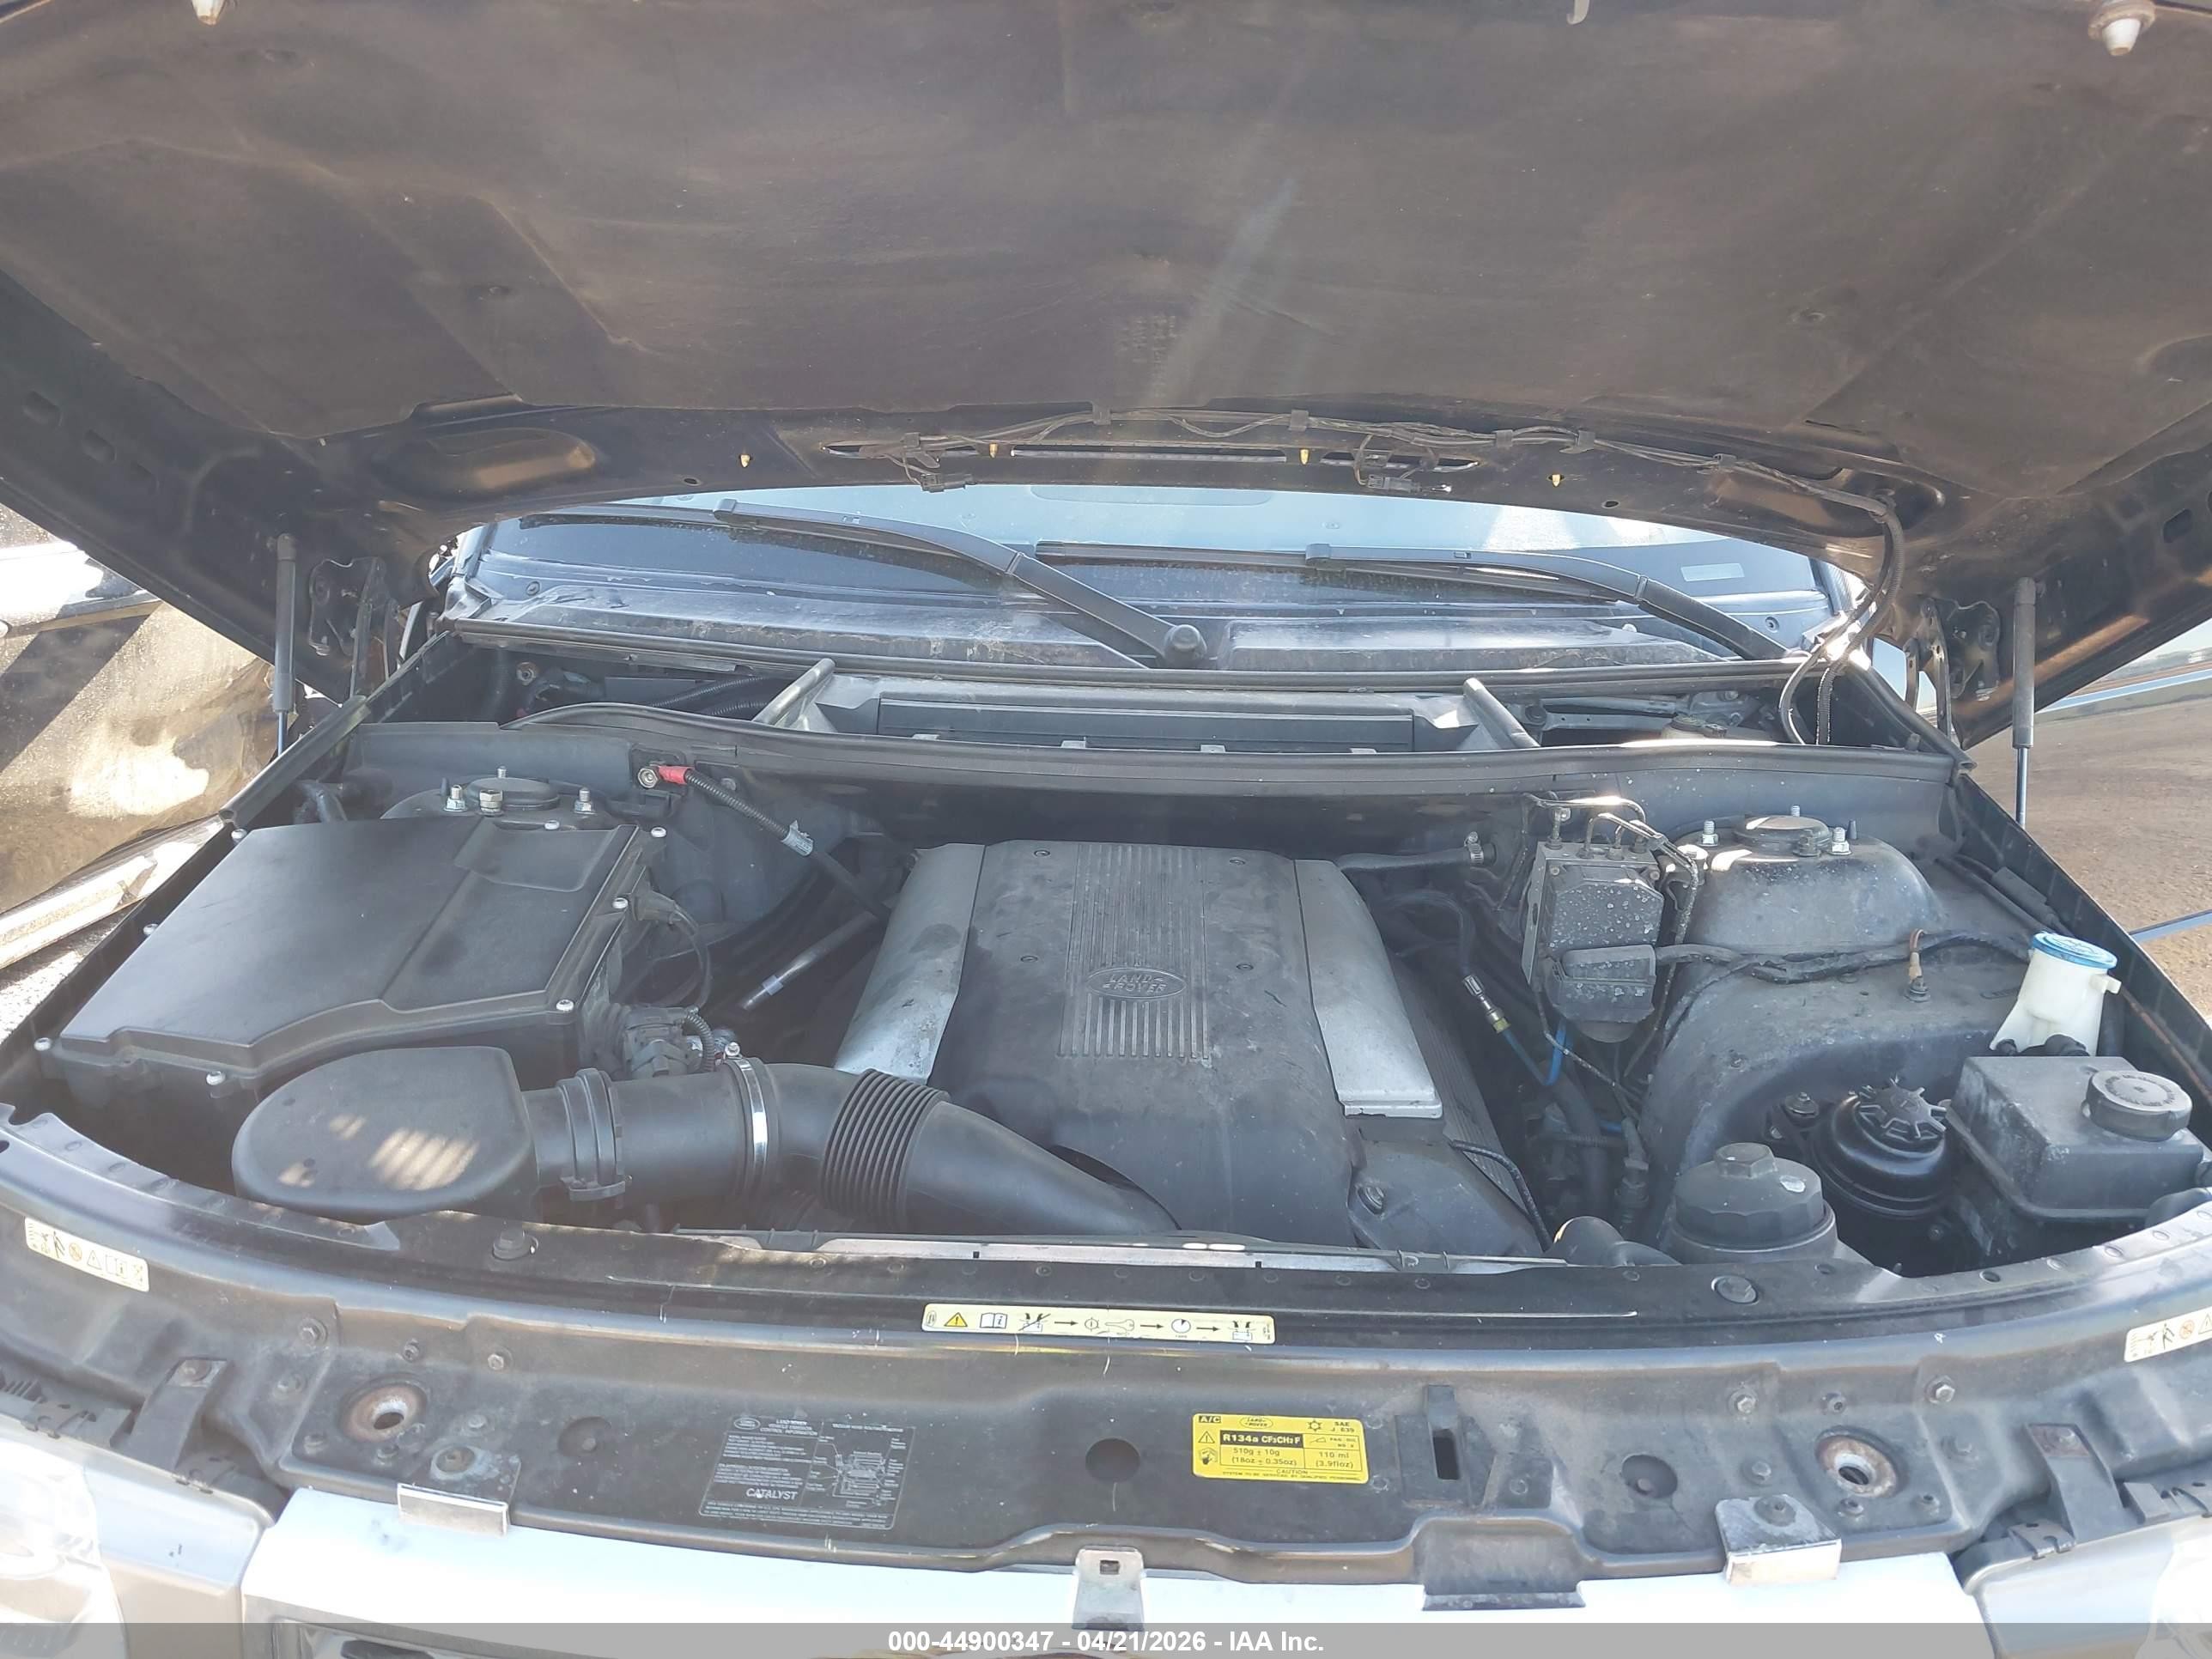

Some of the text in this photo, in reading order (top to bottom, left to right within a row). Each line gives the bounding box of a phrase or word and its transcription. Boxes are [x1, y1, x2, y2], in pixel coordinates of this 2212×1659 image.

[1109, 975, 1152, 983] LAND
[1115, 983, 1167, 994] ROVER
[1222, 1433, 1259, 1443] R134a
[1265, 1458, 1297, 1467] 0.35oz)
[745, 1487, 799, 1501] CATALYST
